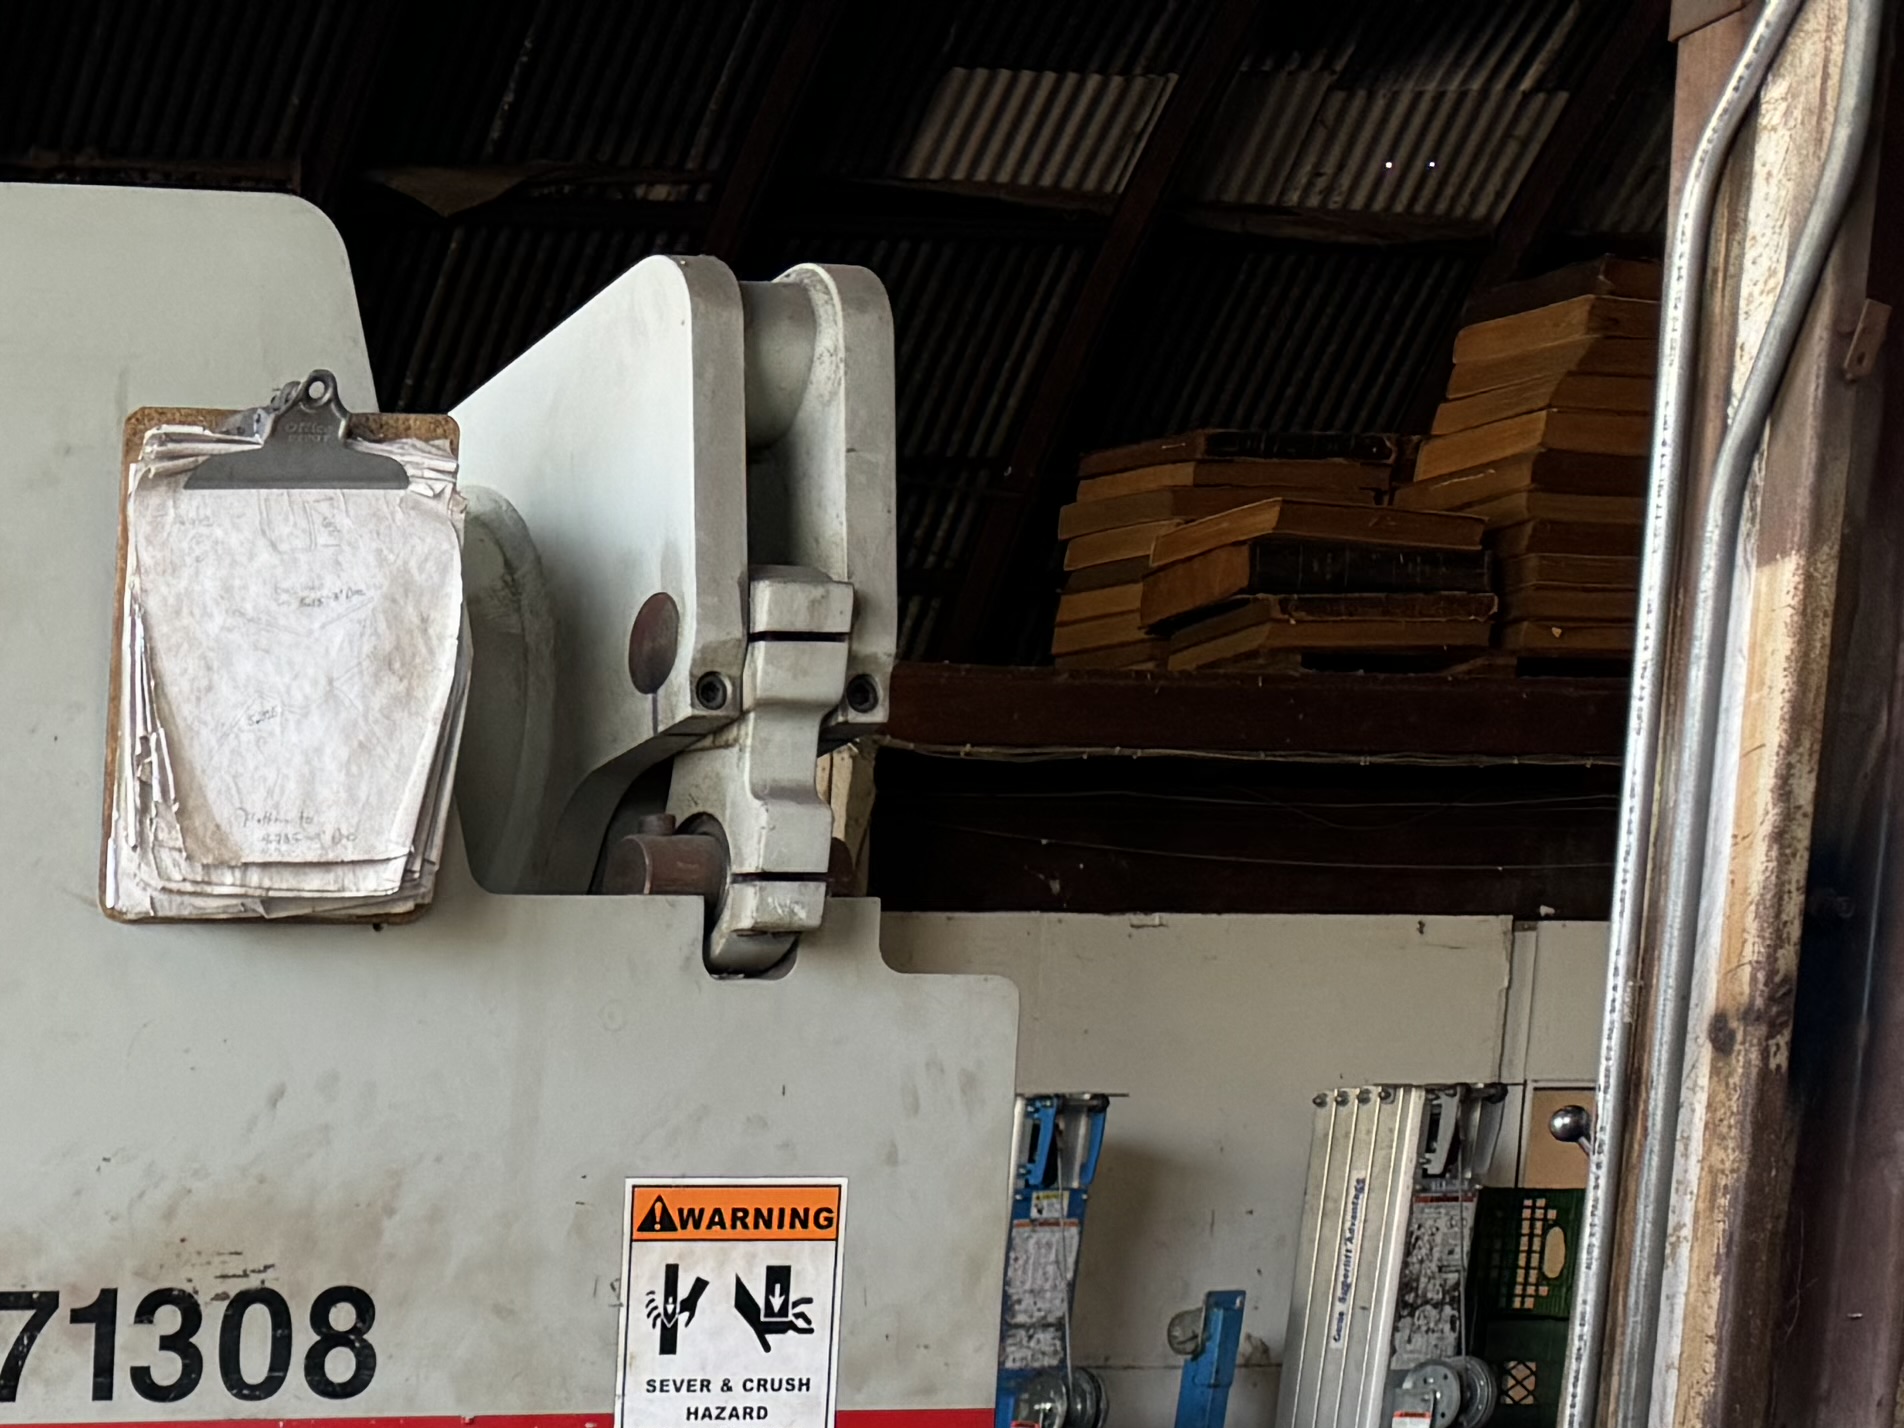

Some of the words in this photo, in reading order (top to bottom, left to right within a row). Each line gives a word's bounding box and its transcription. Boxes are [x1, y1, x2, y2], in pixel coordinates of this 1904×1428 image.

[678, 1207, 834, 1230] WARNING
[646, 1378, 710, 1392] SEVER
[720, 1378, 732, 1392] &
[742, 1377, 810, 1392] CRUSH
[686, 1407, 768, 1421] HAZARD
